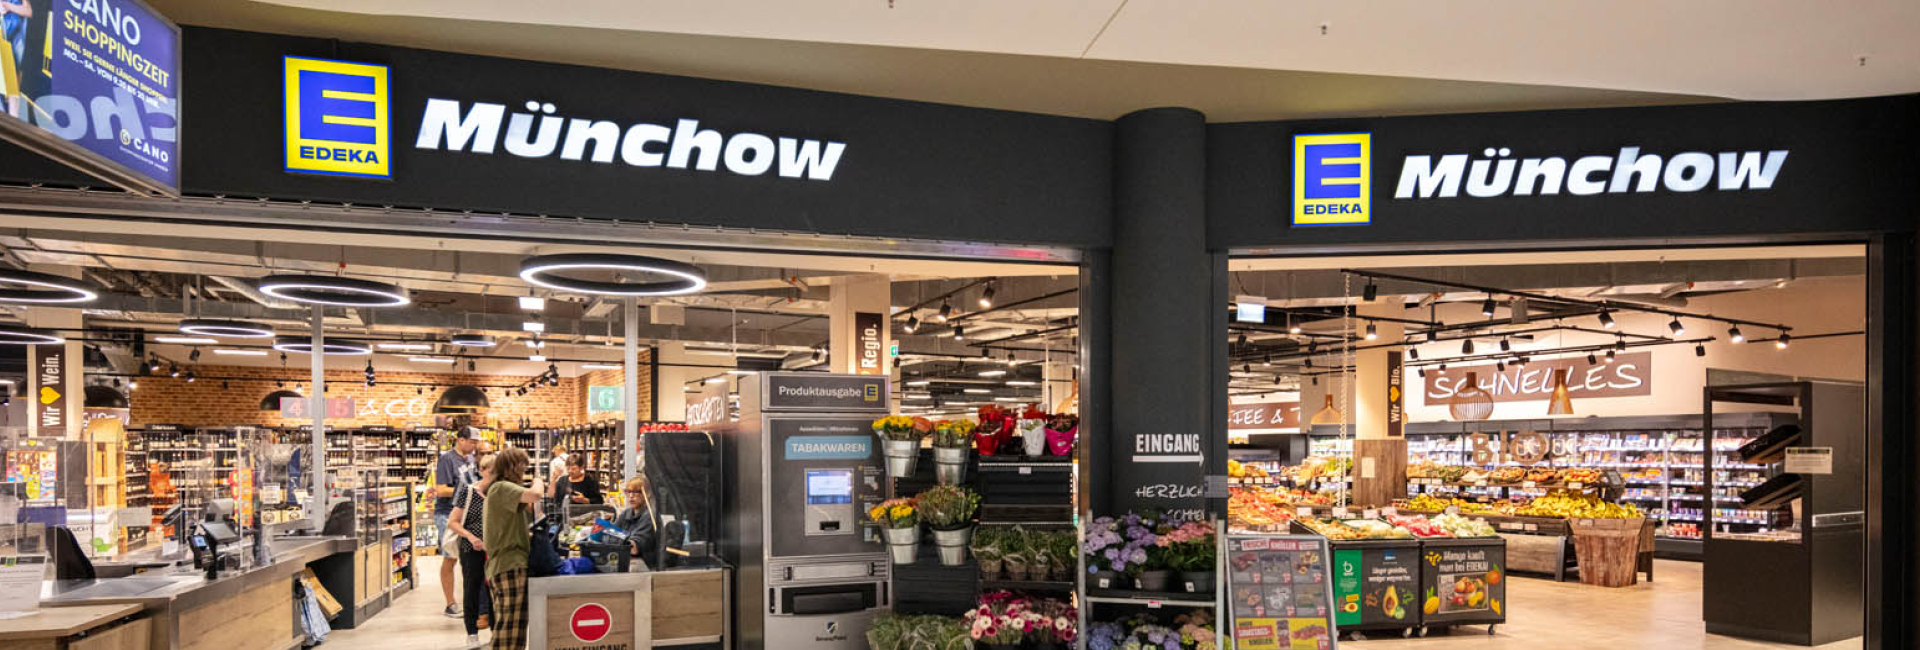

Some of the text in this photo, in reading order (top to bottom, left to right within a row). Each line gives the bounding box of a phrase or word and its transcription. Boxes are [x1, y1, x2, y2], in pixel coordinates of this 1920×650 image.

[64, 10, 169, 88] SHOPPINGZEIT
[415, 97, 846, 181] Münchow
[134, 137, 169, 163] CANO
[299, 145, 379, 165] EDEKA
[1394, 147, 1789, 199] Münchow
[1303, 203, 1362, 215] EDEKA
[861, 323, 880, 369] Regio.
[41, 353, 61, 428] Wir Wein.
[598, 390, 616, 409] 6
[778, 385, 862, 398] Produktausgabe
[1389, 364, 1401, 424] Wir Bio.
[289, 402, 302, 416] 4
[1270, 408, 1284, 424] &
[791, 443, 866, 453] TABAKWAREN
[1135, 433, 1200, 453] EINGANG
